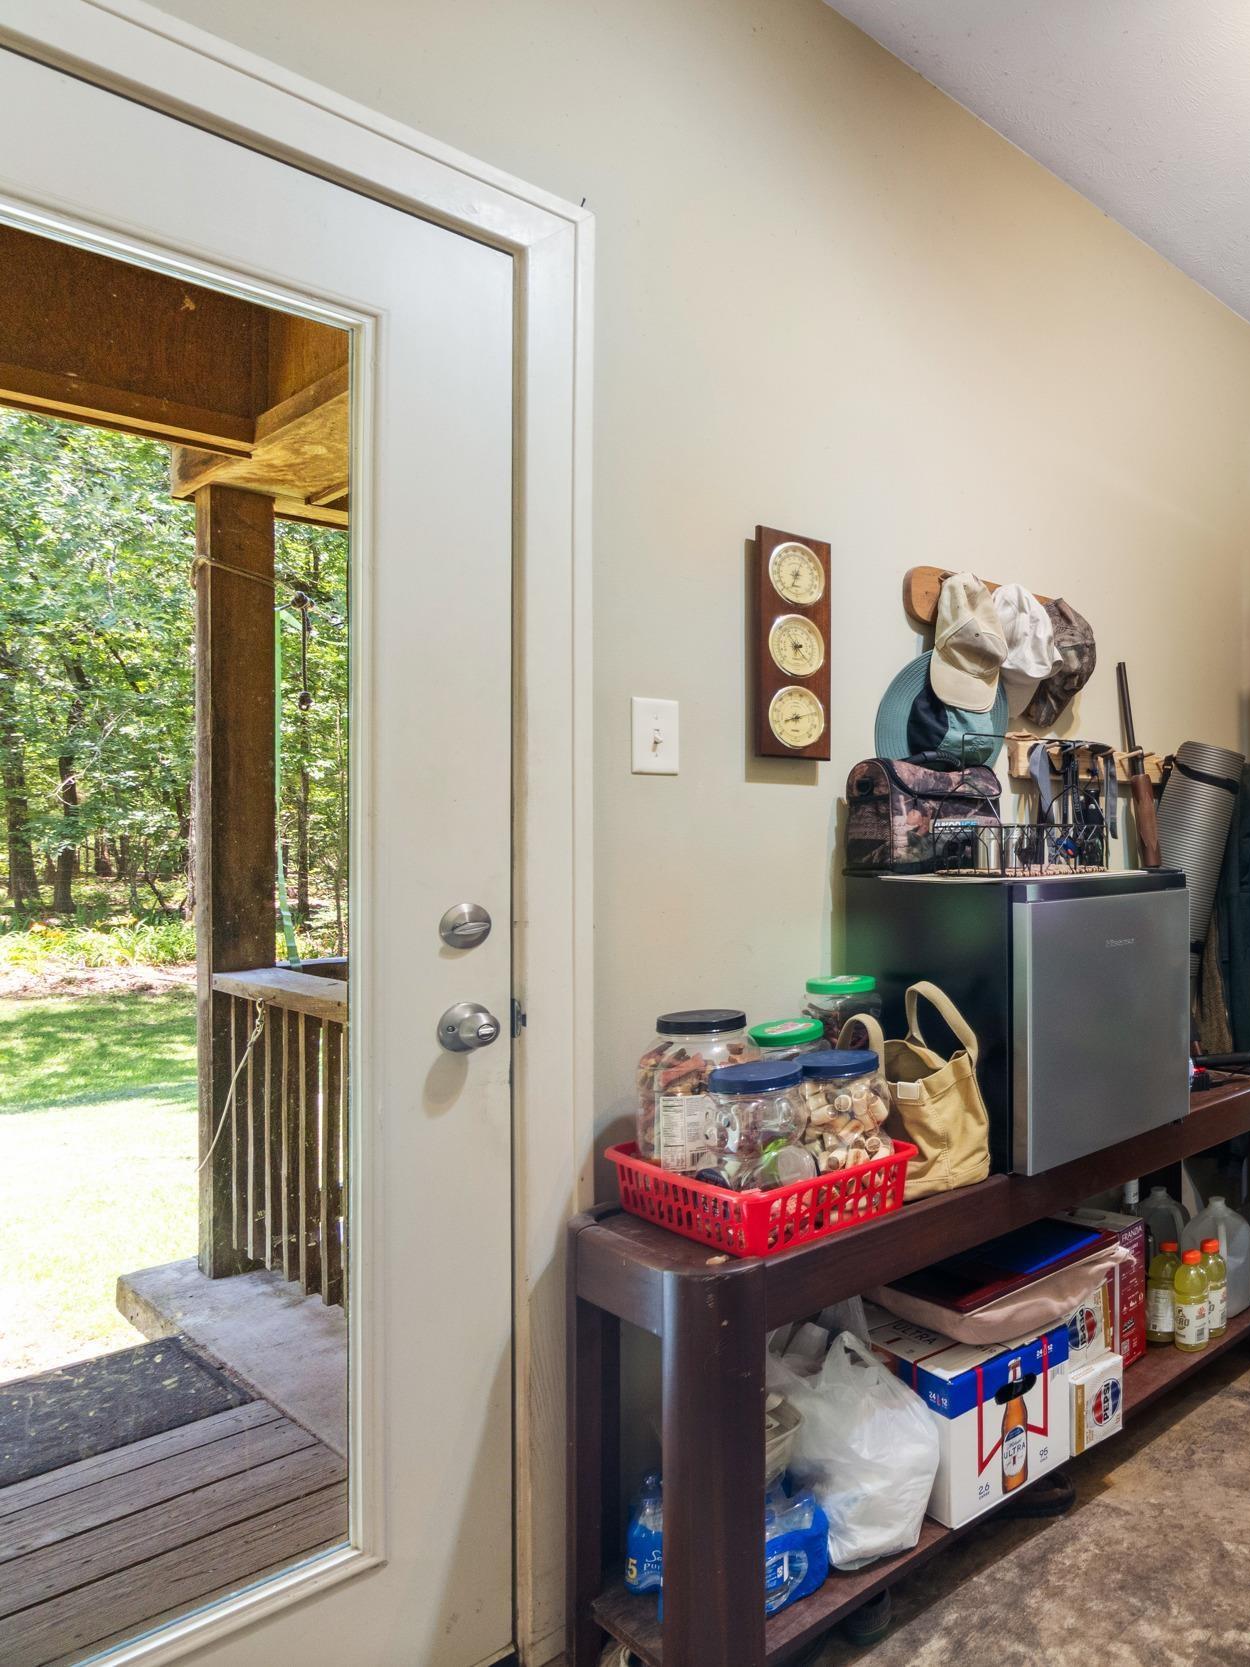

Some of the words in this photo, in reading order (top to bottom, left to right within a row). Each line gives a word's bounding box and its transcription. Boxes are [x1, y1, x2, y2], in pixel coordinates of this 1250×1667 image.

[1121, 1225, 1142, 1243] FRANZIA
[893, 1322, 936, 1345] ULTRA
[1079, 1308, 1087, 1346] PEPSI
[1103, 1382, 1112, 1421] PEPSI
[1003, 1442, 1025, 1460] ULTRA
[1039, 1446, 1049, 1459] 95
[978, 1481, 990, 1496] 2.6
